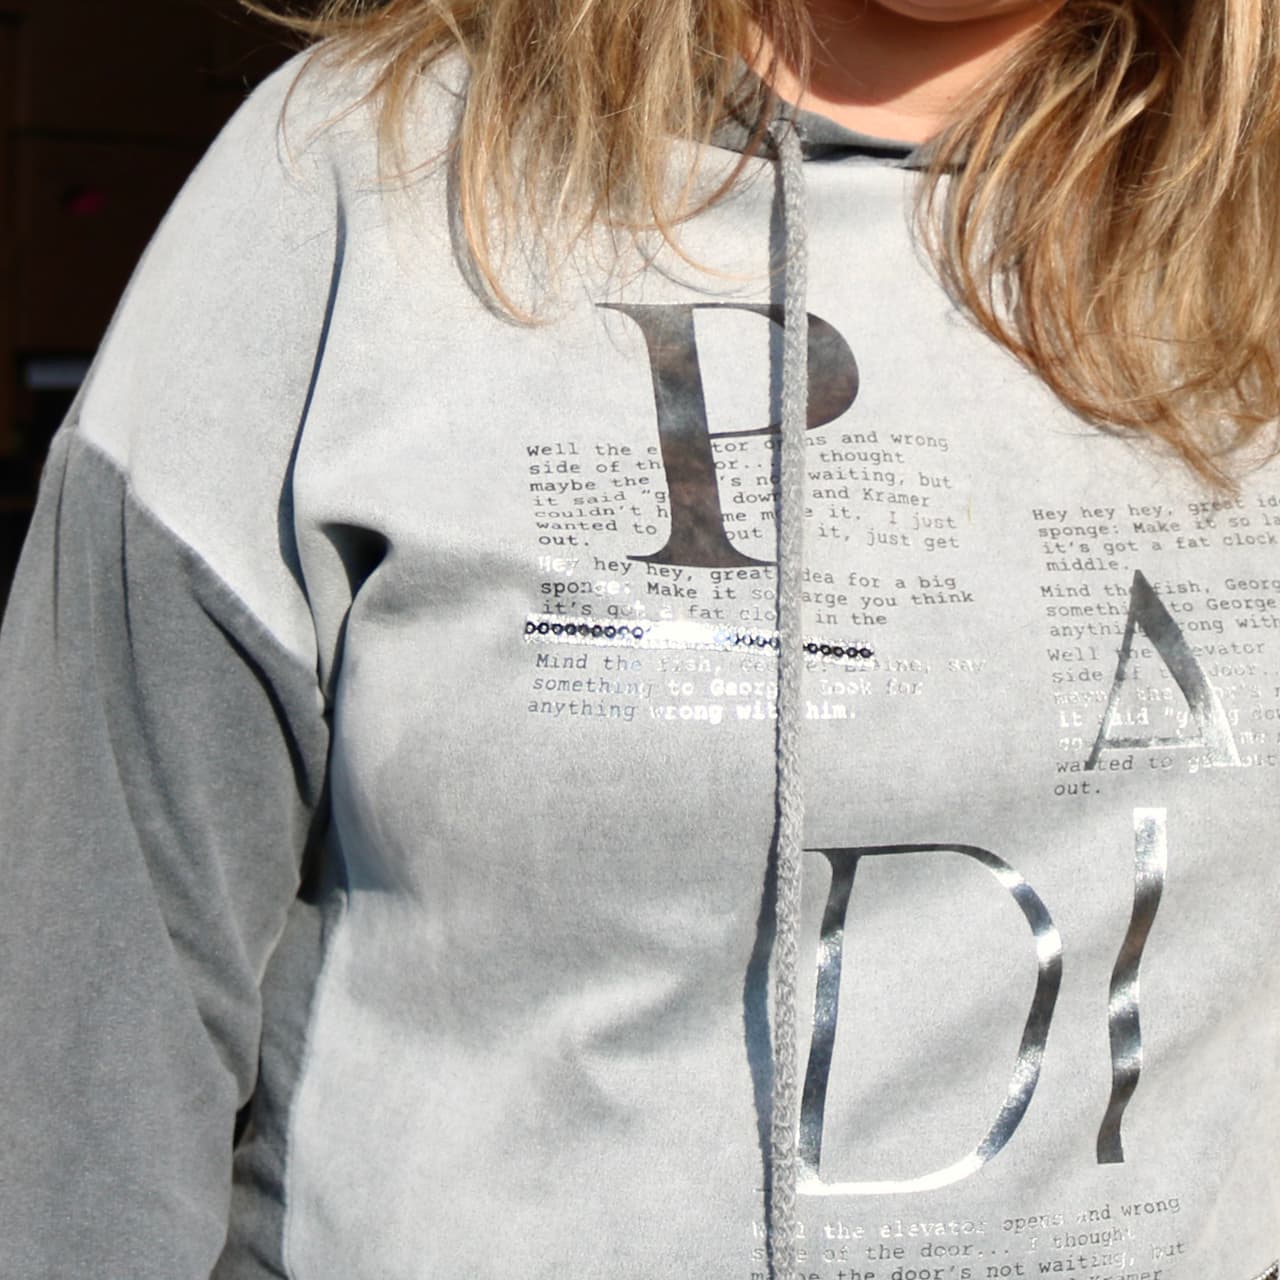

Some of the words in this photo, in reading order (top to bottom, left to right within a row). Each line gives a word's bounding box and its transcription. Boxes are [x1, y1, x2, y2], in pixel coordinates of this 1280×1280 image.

[527, 442, 579, 457] Well
[595, 443, 632, 456] the
[841, 431, 879, 444] and
[890, 433, 950, 452] wrong
[529, 461, 581, 474] side
[596, 462, 620, 473] of
[820, 450, 905, 465] thought
[530, 480, 596, 494] maybe
[612, 476, 650, 487] the
[808, 467, 905, 487] waiting,
[919, 472, 952, 489] but
[532, 497, 558, 506] it
[573, 493, 626, 506] said
[812, 486, 849, 499] and
[863, 487, 931, 507] Kramer
[534, 505, 641, 518] couldn't
[829, 506, 861, 520] it.
[912, 513, 958, 530] just
[1032, 508, 1068, 523] Hey
[1080, 506, 1115, 520] hey
[1128, 504, 1173, 517] hey,
[535, 520, 617, 531] wanted
[634, 522, 657, 535] to
[818, 524, 850, 542] it,
[867, 528, 910, 547] just
[924, 535, 961, 551] get
[1038, 524, 1119, 538] sponge:
[1133, 522, 1180, 533] Make
[1228, 517, 1250, 528] so
[538, 535, 589, 546] out.
[1042, 541, 1091, 554] it's
[1103, 540, 1139, 555] got
[1152, 541, 1162, 551] a
[1176, 536, 1211, 549] fat
[1223, 532, 1278, 546] clock
[537, 556, 579, 576] Hey
[593, 557, 632, 573] hey
[646, 561, 693, 582] hey,
[710, 566, 773, 584] great
[848, 572, 881, 588] for
[895, 578, 905, 589] a
[919, 576, 956, 590] big
[1046, 558, 1129, 571] middle.
[646, 582, 697, 599] Make
[712, 587, 736, 599] it
[751, 588, 775, 600] so
[859, 594, 897, 610] you
[911, 591, 974, 605] think
[1040, 583, 1091, 598] Mind
[1154, 581, 1210, 594] fish,
[541, 602, 592, 616] it's
[607, 600, 646, 619] got
[688, 604, 726, 619] fat
[815, 610, 838, 624] in
[851, 612, 888, 625] the
[1170, 600, 1194, 612] to
[535, 653, 588, 670] Mind
[604, 656, 641, 671] the
[1047, 646, 1099, 662] Well
[1052, 668, 1103, 683] side
[533, 677, 653, 699] something
[669, 680, 694, 694] to
[819, 679, 873, 696] Look
[886, 679, 924, 696] for
[527, 699, 638, 720] anything
[650, 705, 723, 724] wrong
[806, 701, 857, 720] him.
[1149, 755, 1173, 769] to
[1054, 781, 1101, 796] out.
[823, 1223, 865, 1240] the
[880, 1219, 985, 1238] elevator
[1003, 1215, 1064, 1234] opens
[1076, 1204, 1111, 1224] and
[1121, 1198, 1180, 1217] wrong
[823, 1246, 849, 1263] of
[867, 1244, 905, 1260] the
[919, 1242, 1009, 1258] door...
[1052, 1226, 1136, 1248] thought
[838, 1269, 874, 1280] the
[891, 1265, 971, 1280] door's
[986, 1263, 1025, 1278] not
[1038, 1252, 1135, 1273] waiting,
[1151, 1241, 1185, 1259] but
